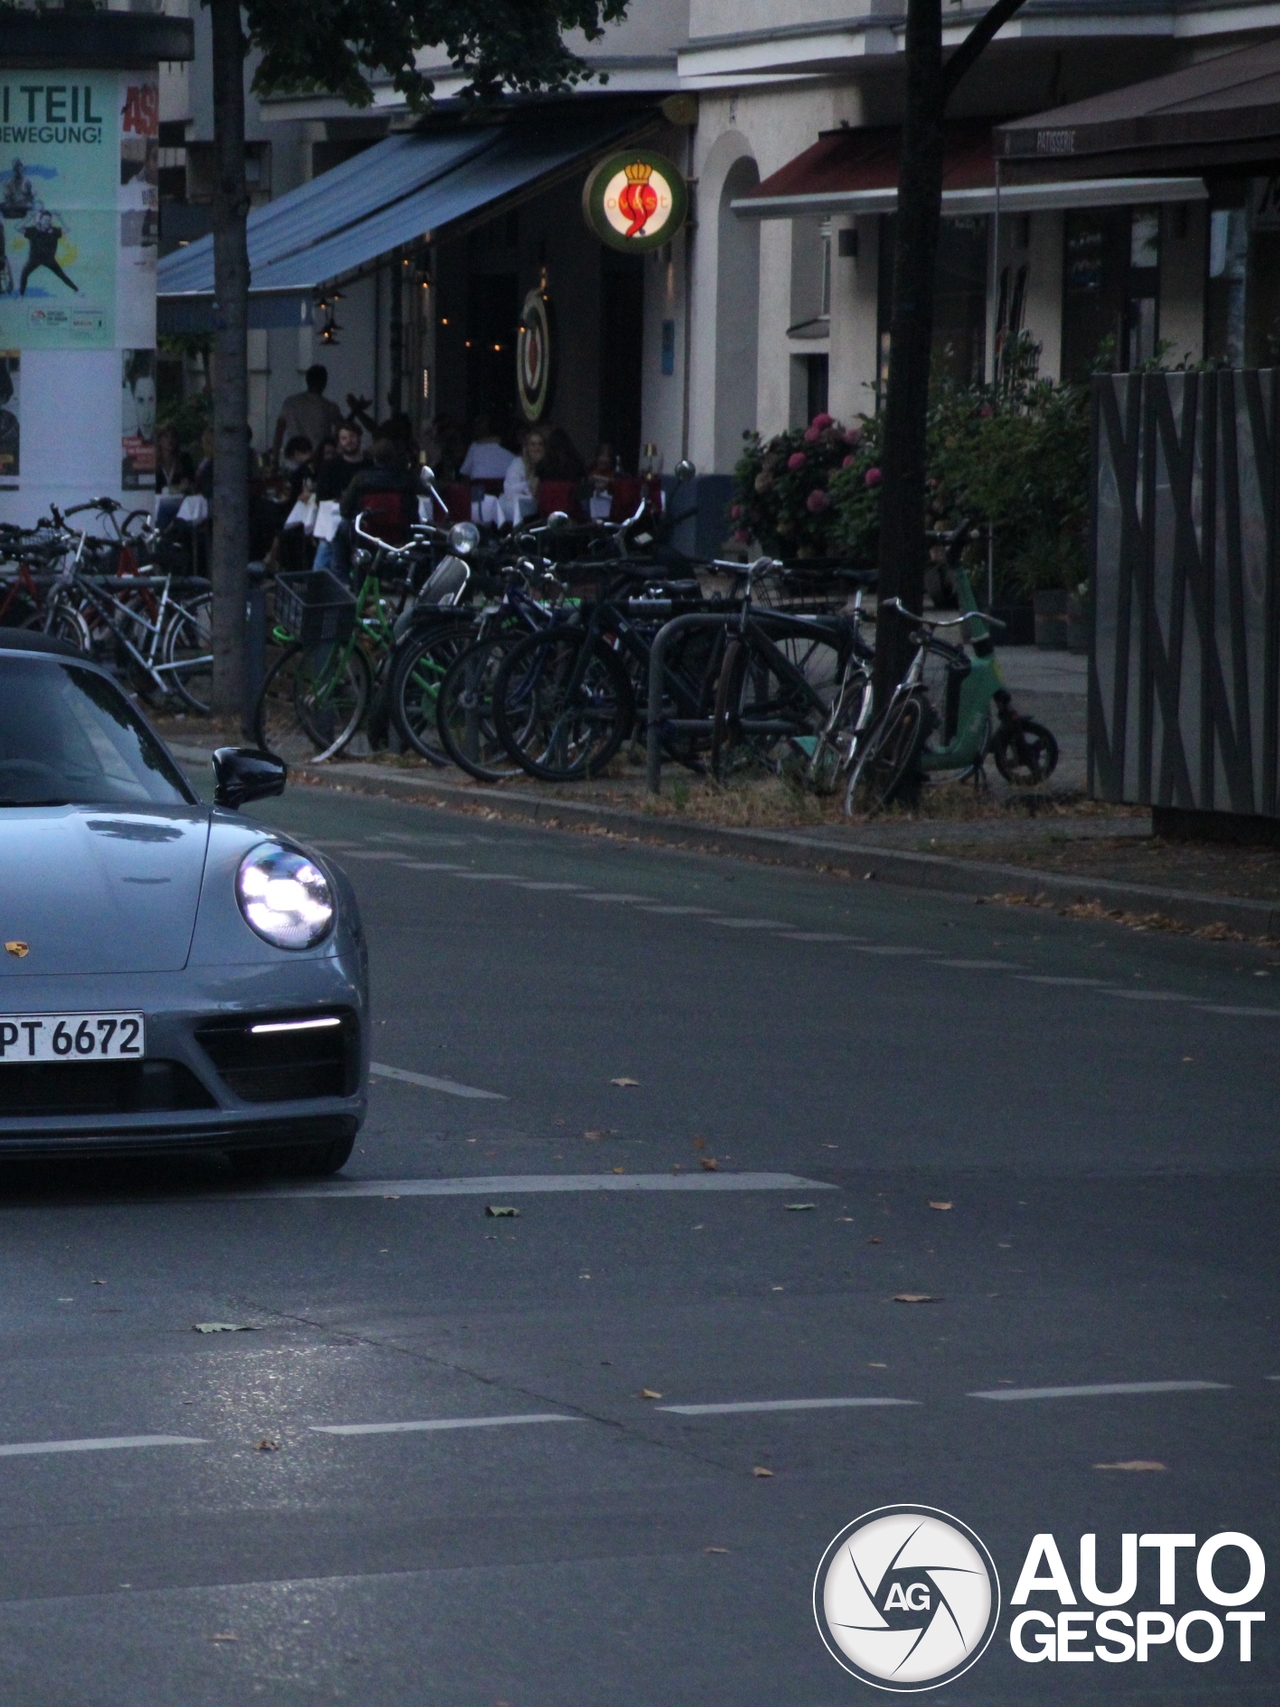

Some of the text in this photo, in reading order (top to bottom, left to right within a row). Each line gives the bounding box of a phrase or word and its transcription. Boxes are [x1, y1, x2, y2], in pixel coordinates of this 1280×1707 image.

[20, 85, 102, 123] TEIL
[123, 83, 158, 136] AS
[1036, 130, 1076, 154] PATISSERIE
[52, 1019, 140, 1055] 6672
